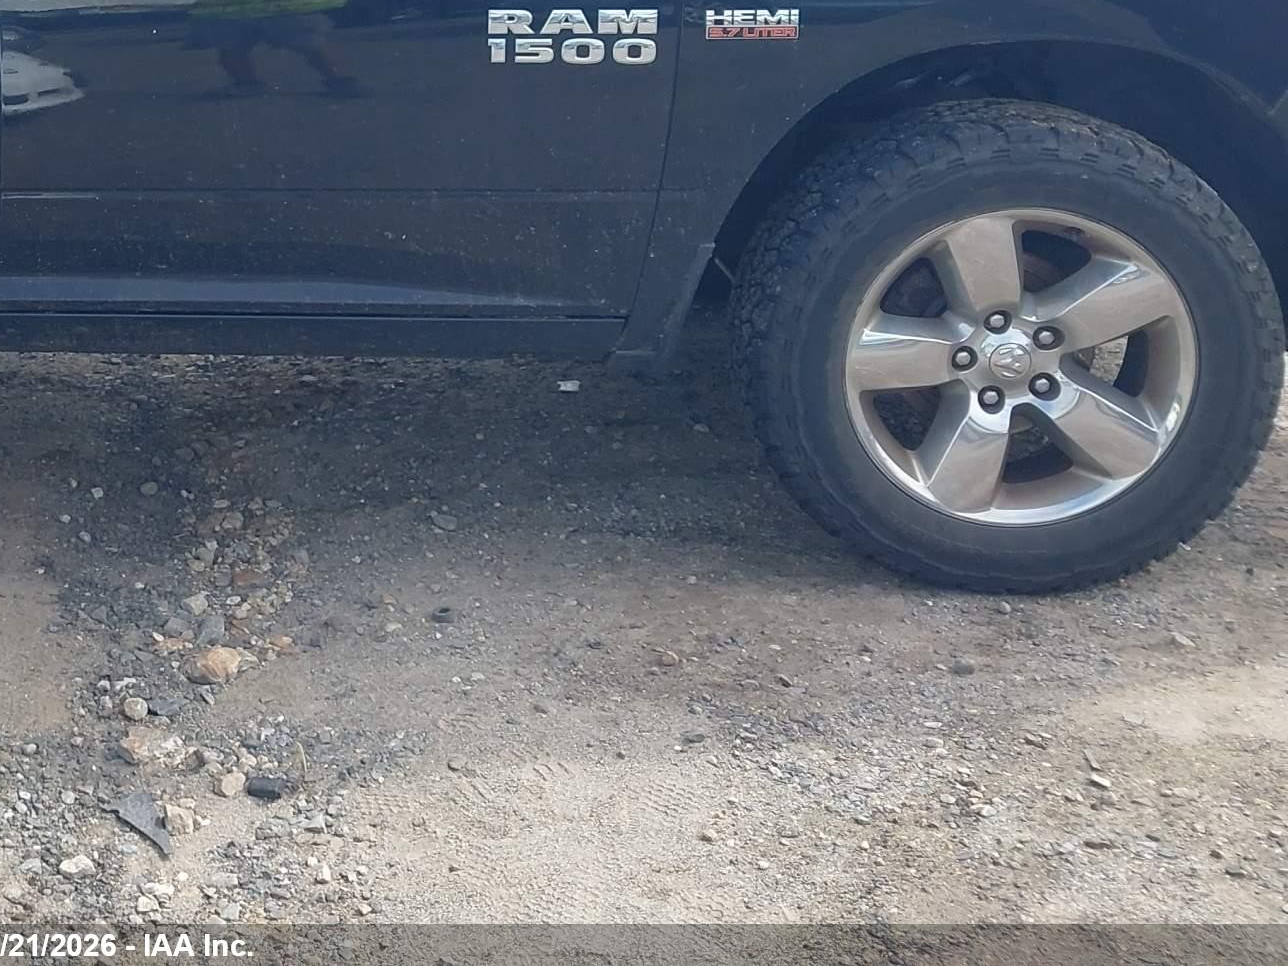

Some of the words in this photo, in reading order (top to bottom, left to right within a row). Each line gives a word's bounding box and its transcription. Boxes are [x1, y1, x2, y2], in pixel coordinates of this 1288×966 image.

[487, 9, 659, 35] RAM
[705, 8, 800, 26] HEMI
[708, 27, 738, 38] 5.7
[742, 27, 797, 38] LITER
[487, 38, 658, 65] 1500
